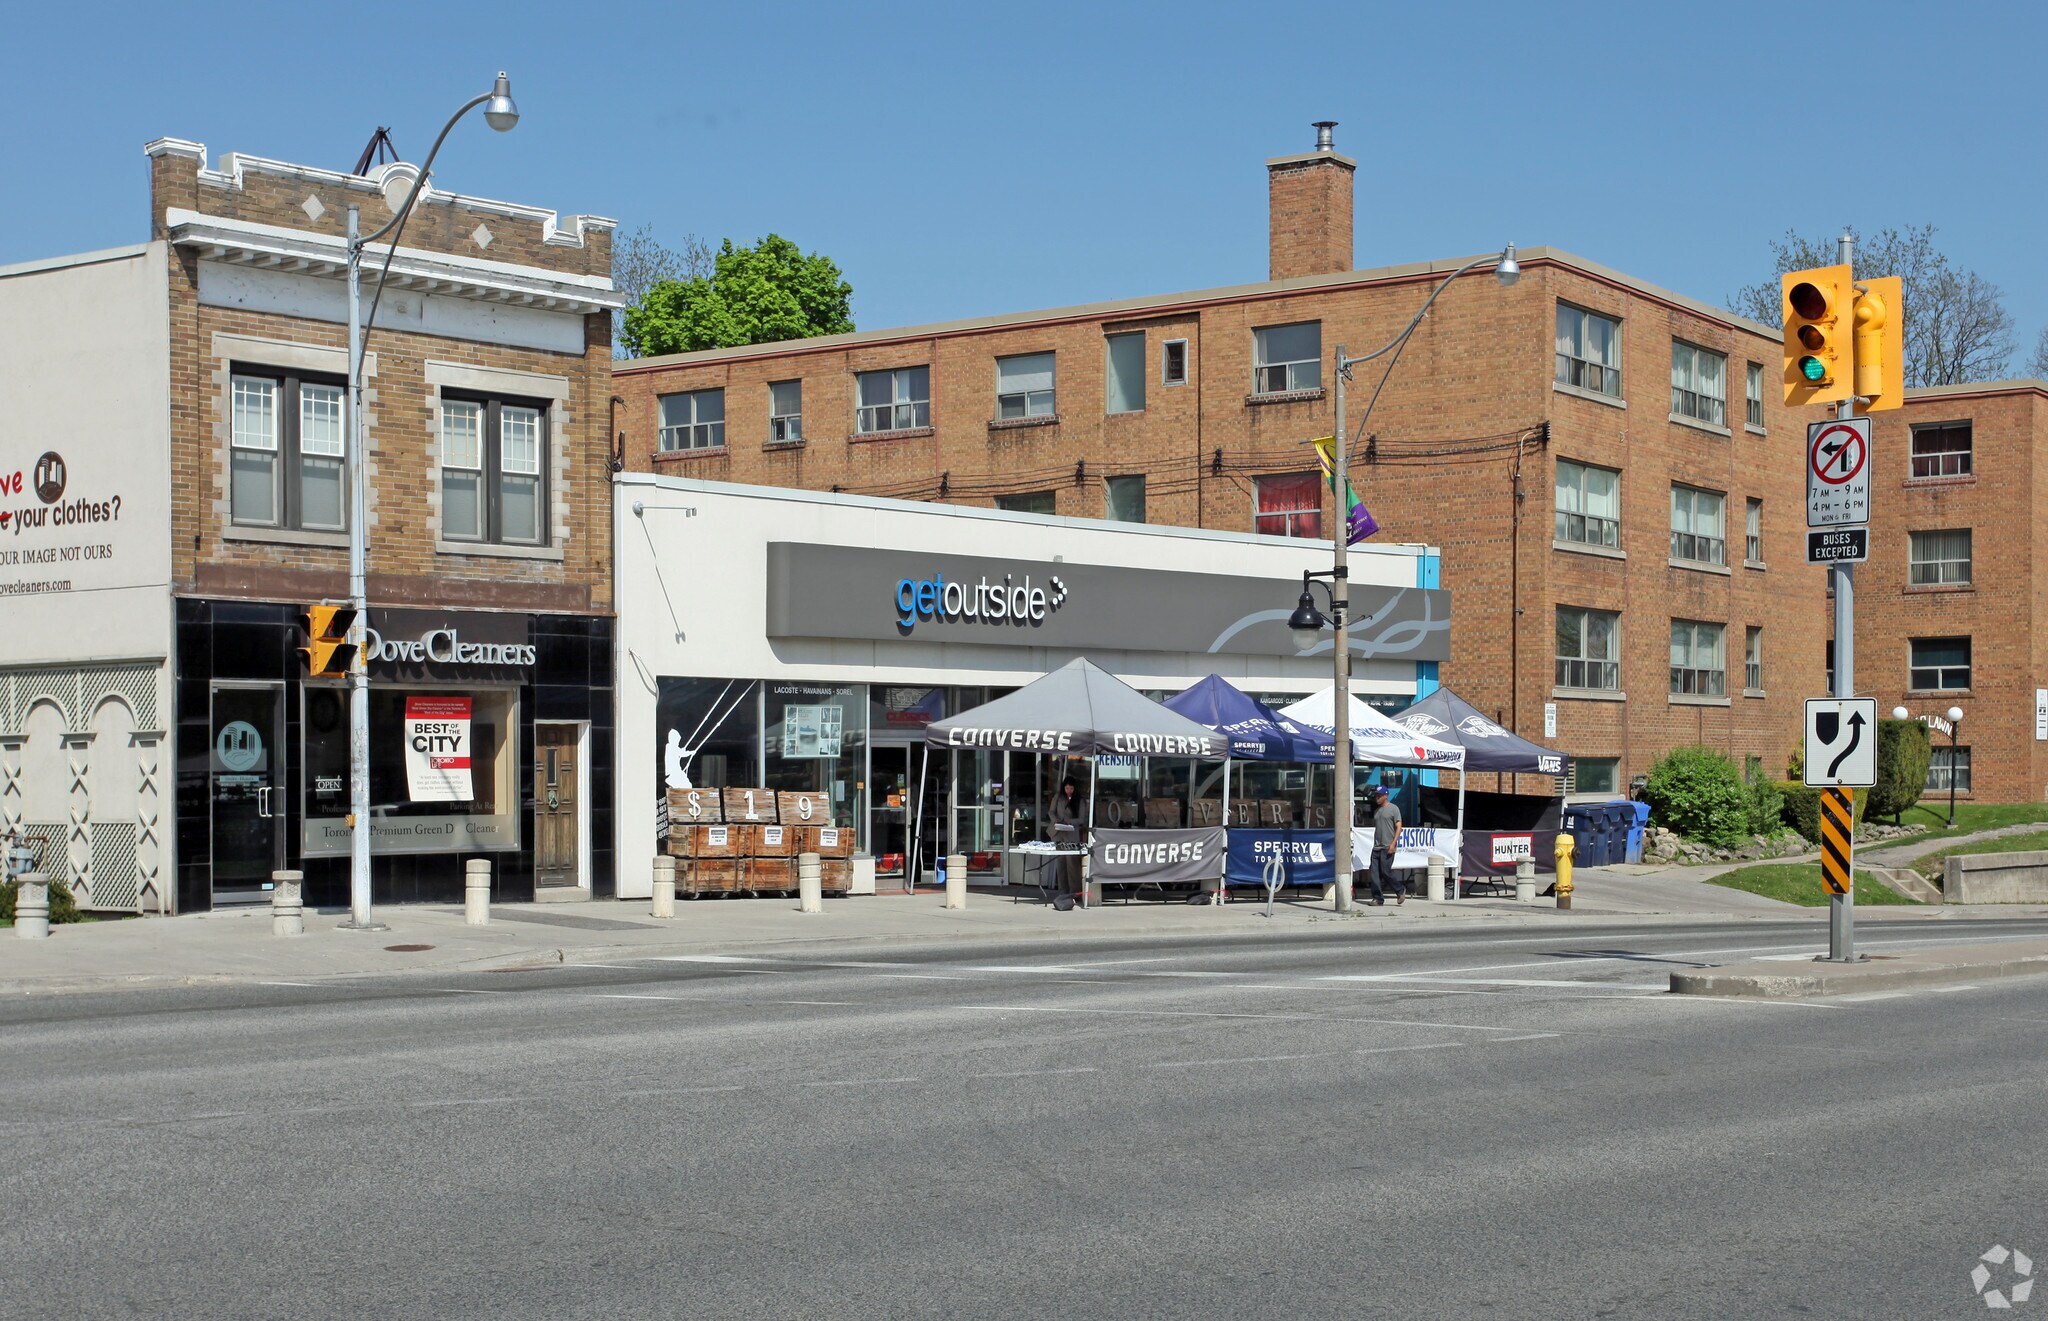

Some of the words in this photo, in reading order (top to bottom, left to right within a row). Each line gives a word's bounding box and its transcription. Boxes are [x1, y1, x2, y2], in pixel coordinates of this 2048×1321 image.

[0, 471, 23, 497] ve
[1812, 488, 1818, 498] 7
[1820, 489, 1830, 498] AM
[1844, 484, 1851, 495] 9
[1853, 486, 1864, 495] AM
[1812, 502, 1819, 512] 4
[1821, 503, 1831, 512] PM
[1844, 499, 1851, 510] 6
[1853, 500, 1864, 509] PM
[14, 507, 48, 536] your
[53, 495, 121, 526] clothes?
[1821, 514, 1834, 522] MON
[1823, 533, 1851, 546] BUSES
[0, 551, 19, 566] OUR
[23, 549, 57, 565] IMAGE
[60, 547, 81, 562] NOT
[84, 544, 112, 560] OURS
[1815, 546, 1858, 559] EXCEPTED
[0, 579, 71, 595] ovecleaners.com
[421, 628, 536, 666] Cleaners
[774, 686, 799, 694] LACOSTE
[836, 688, 854, 696] SOREL
[414, 723, 450, 734] BEST
[1928, 715, 1953, 736] LAWN
[412, 735, 462, 753] CITY
[949, 727, 1073, 751] CONVERSE
[1114, 733, 1211, 756] CONVERSE
[1537, 755, 1562, 773] VANS
[317, 781, 340, 789] OPEN
[322, 826, 352, 838] Toron
[370, 825, 412, 836] Premium
[415, 823, 442, 835] Green
[1397, 828, 1436, 848] ENSTOCK
[1104, 842, 1203, 864] CONVERSE
[1254, 841, 1309, 853] SPERRY
[1495, 844, 1529, 855] HUNTER
